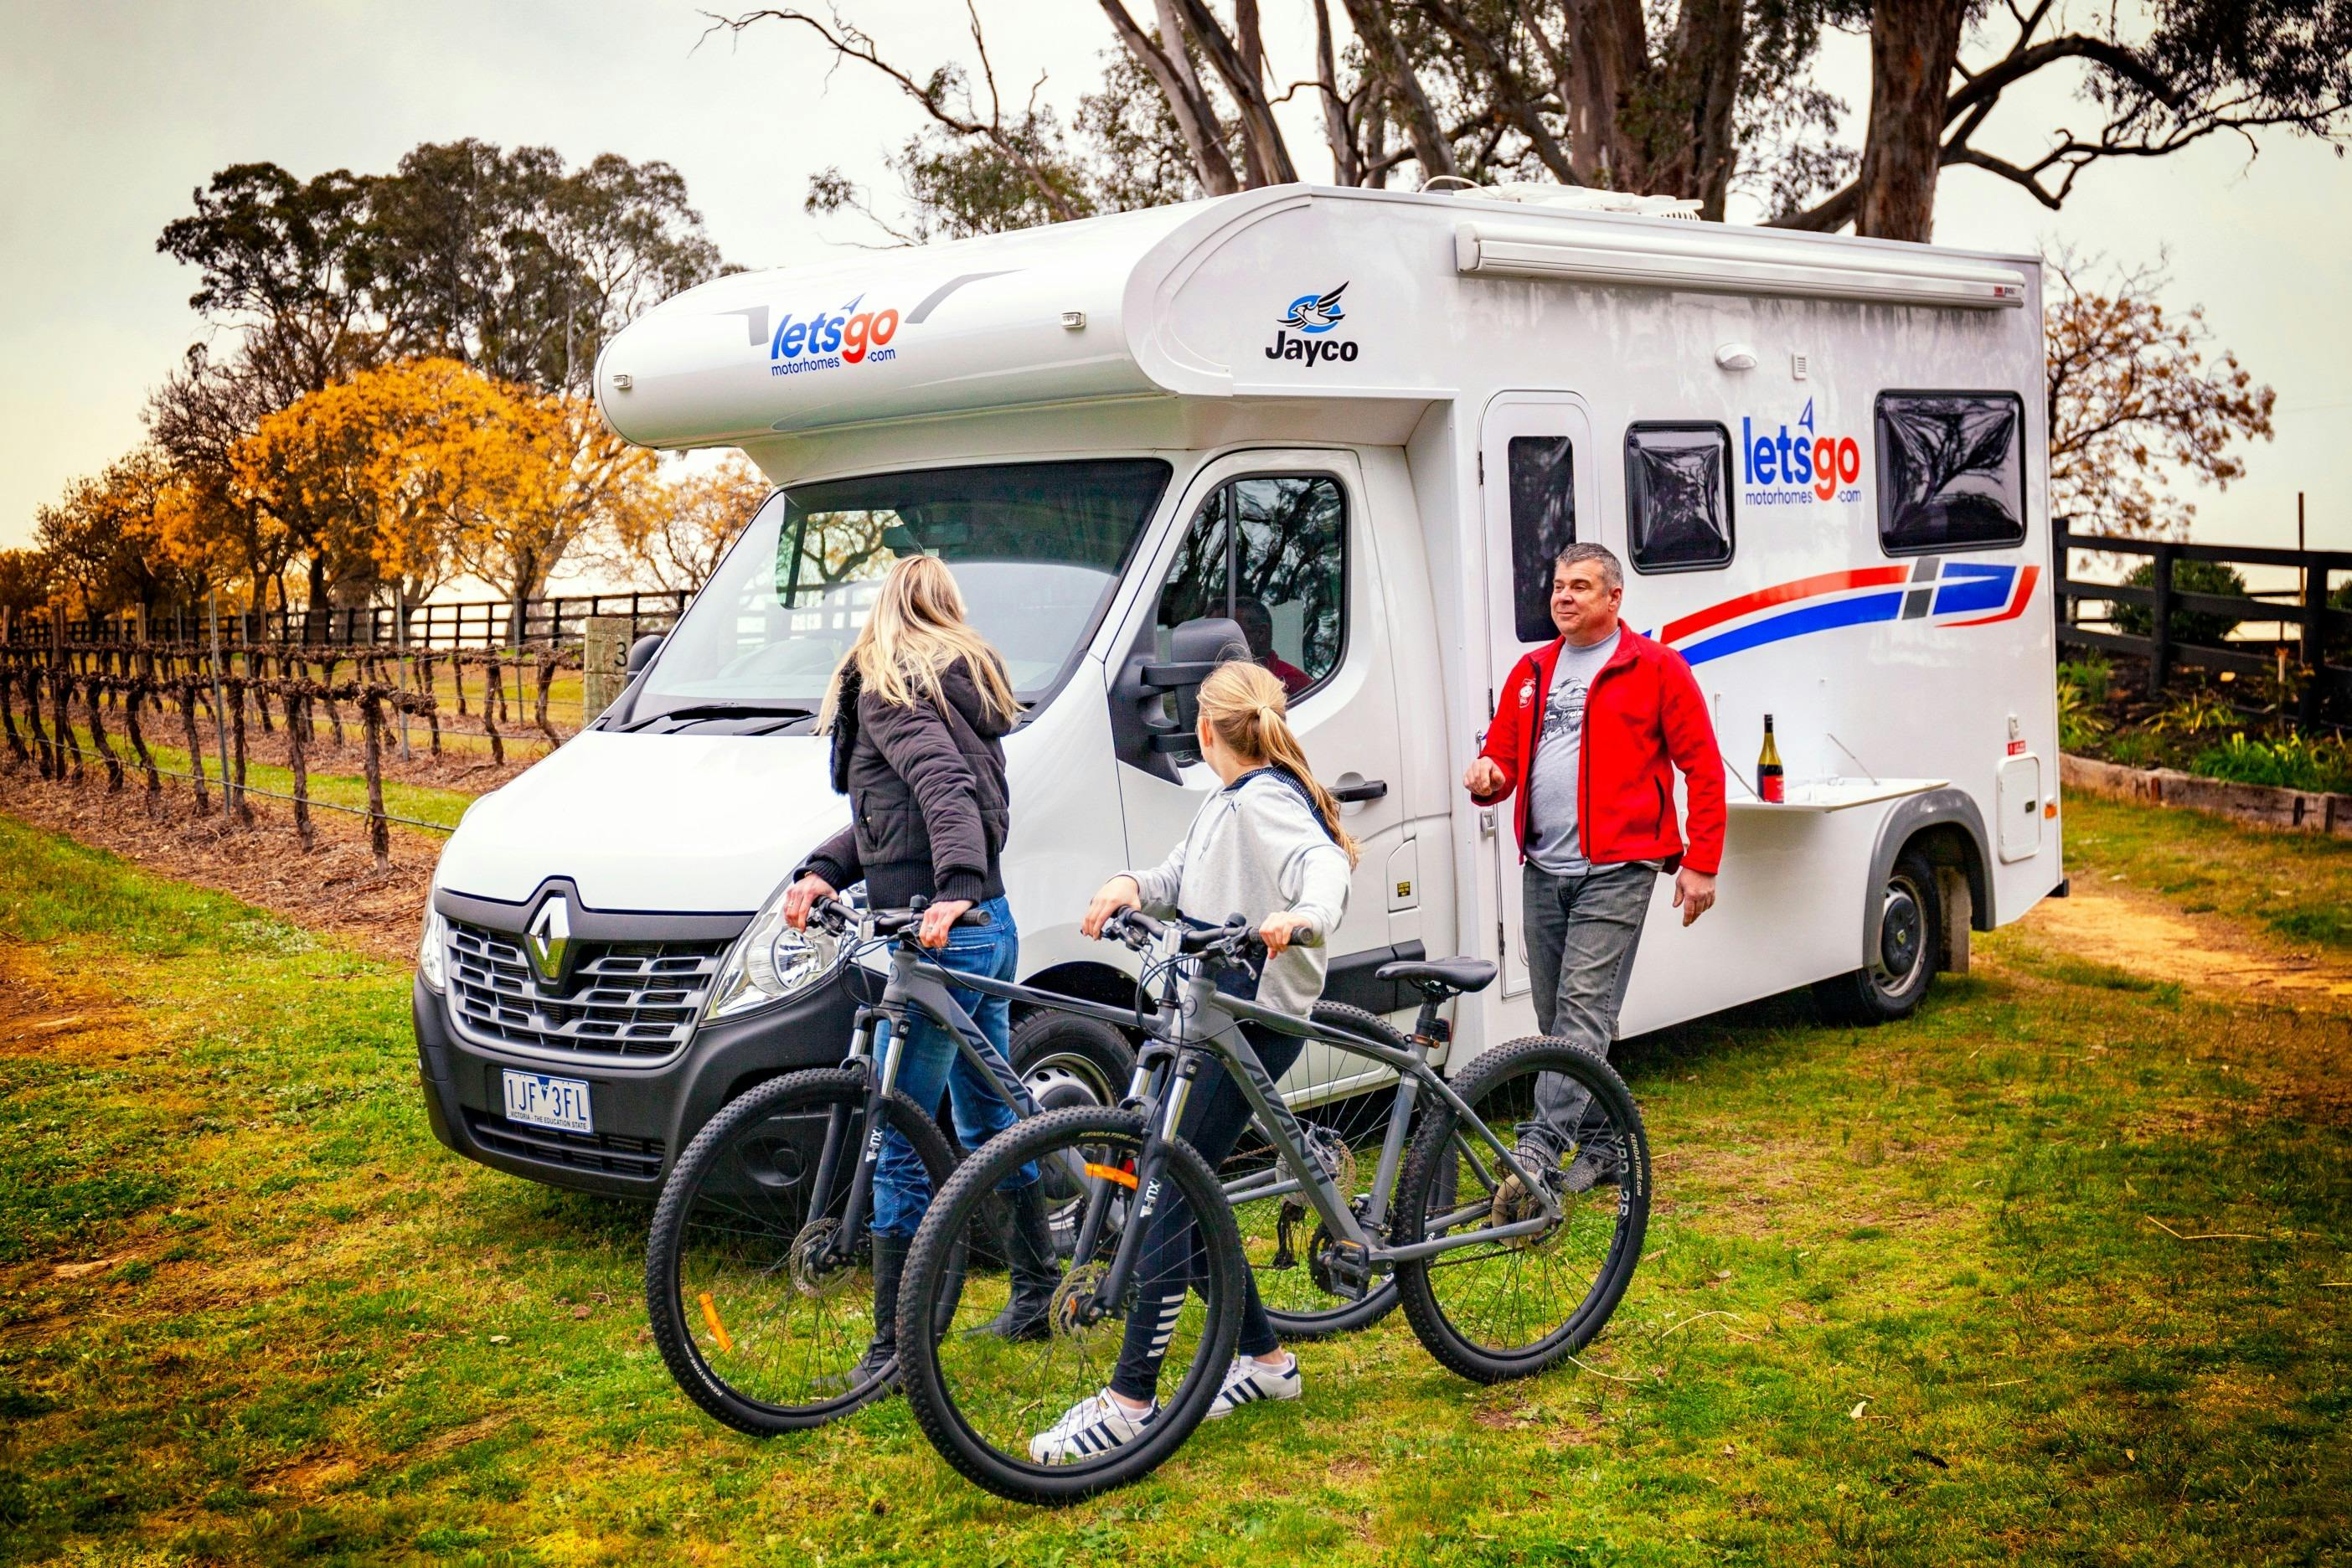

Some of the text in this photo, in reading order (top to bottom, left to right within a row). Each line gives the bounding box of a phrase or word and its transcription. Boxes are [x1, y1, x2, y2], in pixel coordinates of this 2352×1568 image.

[771, 348, 896, 376] motorhomes .com
[1266, 330, 1359, 367] Jayco
[1746, 487, 1862, 505] motorhomes .com
[614, 642, 627, 667] 3
[508, 1079, 587, 1121] 1JF 3FL
[511, 1111, 529, 1120] VICTORIA
[544, 1117, 571, 1127] EDUCATION
[572, 1122, 587, 1130] STATE
[1240, 1060, 1330, 1185] AVANTI
[1629, 1132, 1643, 1197] KENDATIRE.COM
[684, 1343, 723, 1397] KENDATIRE.COM
